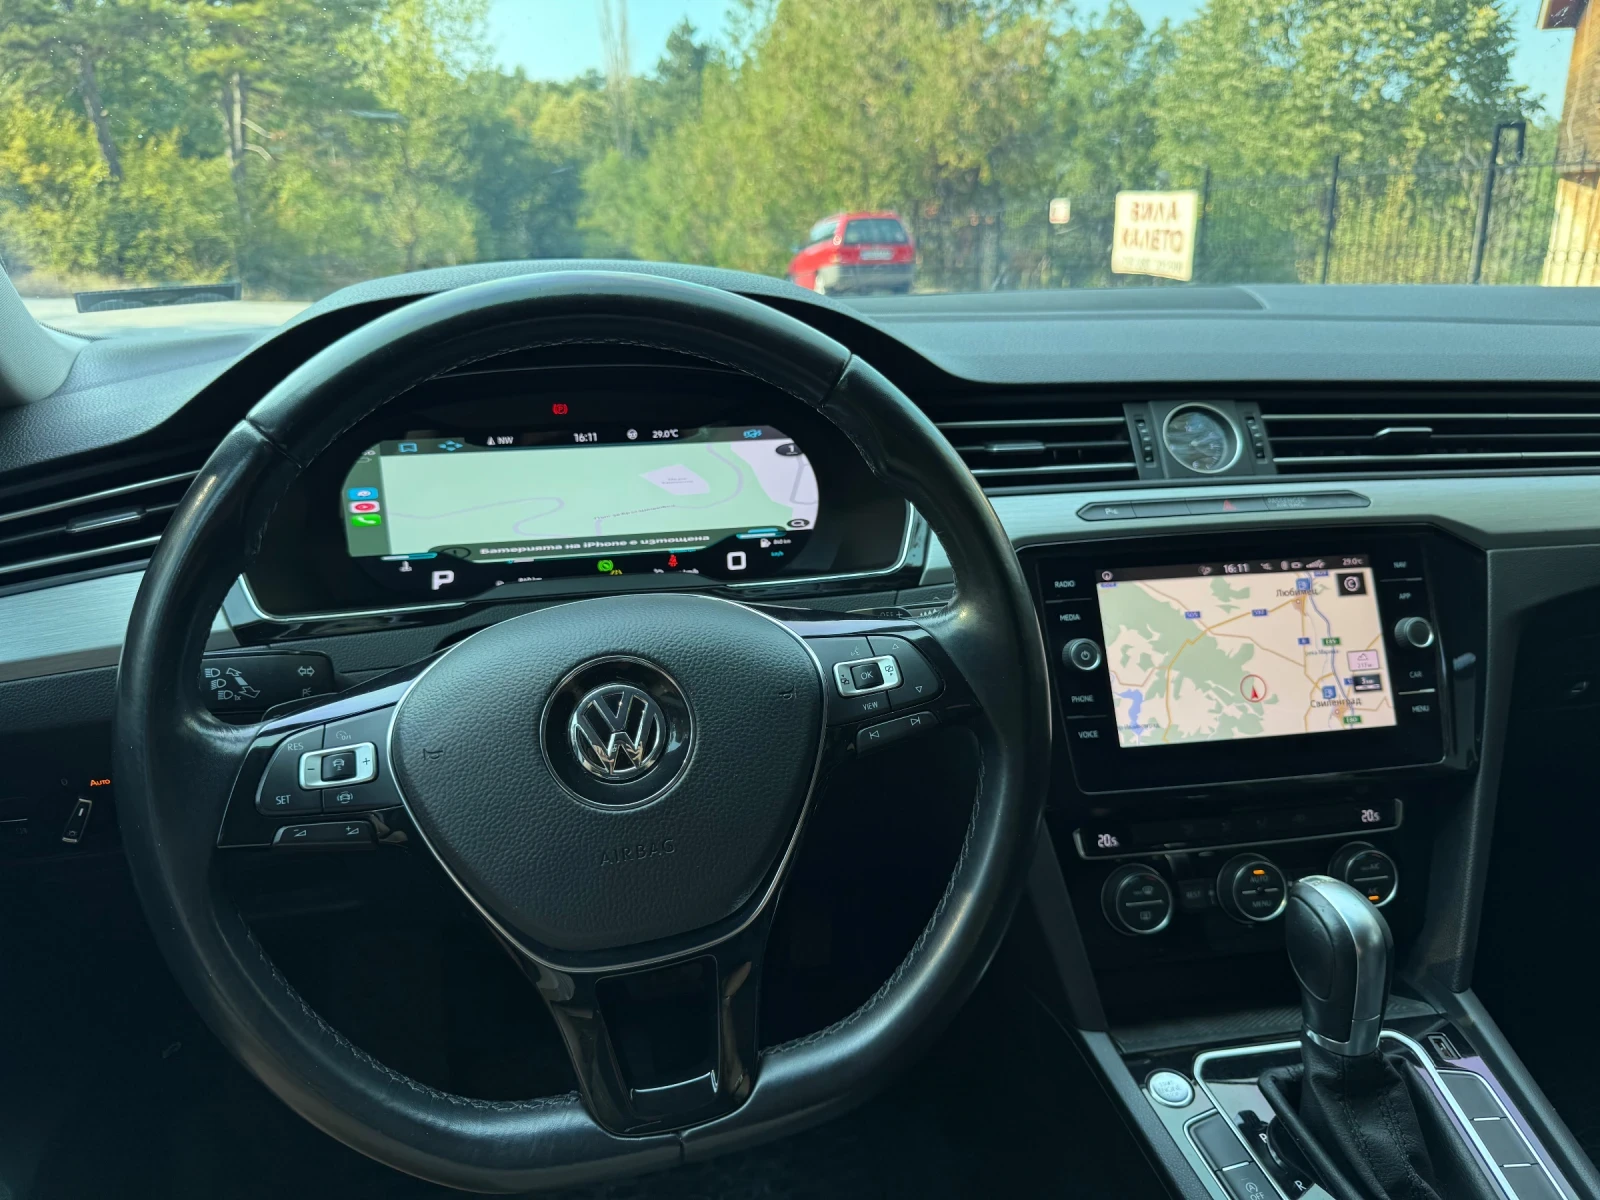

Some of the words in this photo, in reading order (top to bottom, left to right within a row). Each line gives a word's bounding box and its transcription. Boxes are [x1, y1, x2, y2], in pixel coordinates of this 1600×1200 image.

[1130, 202, 1178, 222] ВИЛА
[1122, 227, 1184, 253] КАЛЕТО
[496, 436, 514, 445] NW
[573, 432, 598, 443] 16:11
[565, 542, 581, 550] на
[583, 539, 628, 549] iPhone
[1223, 563, 1249, 574] 16:11
[431, 570, 455, 591] P
[1054, 580, 1076, 588] RADIO
[1276, 588, 1318, 598] Любимец
[1059, 613, 1081, 621] MEDIA
[860, 671, 874, 680] OK
[1071, 695, 1094, 703] PHONE
[1310, 697, 1363, 708] Свиленград
[862, 701, 878, 711] VIEW
[1412, 705, 1430, 713] MENU
[1078, 730, 1099, 738] VOICE
[287, 743, 304, 751] RES
[275, 794, 291, 805] SET
[600, 838, 676, 867] AIRBAG
[1249, 875, 1269, 884] AUTO
[1252, 900, 1272, 908] MENU
[1294, 1180, 1307, 1191] R
[1251, 1191, 1265, 1200] OFF
